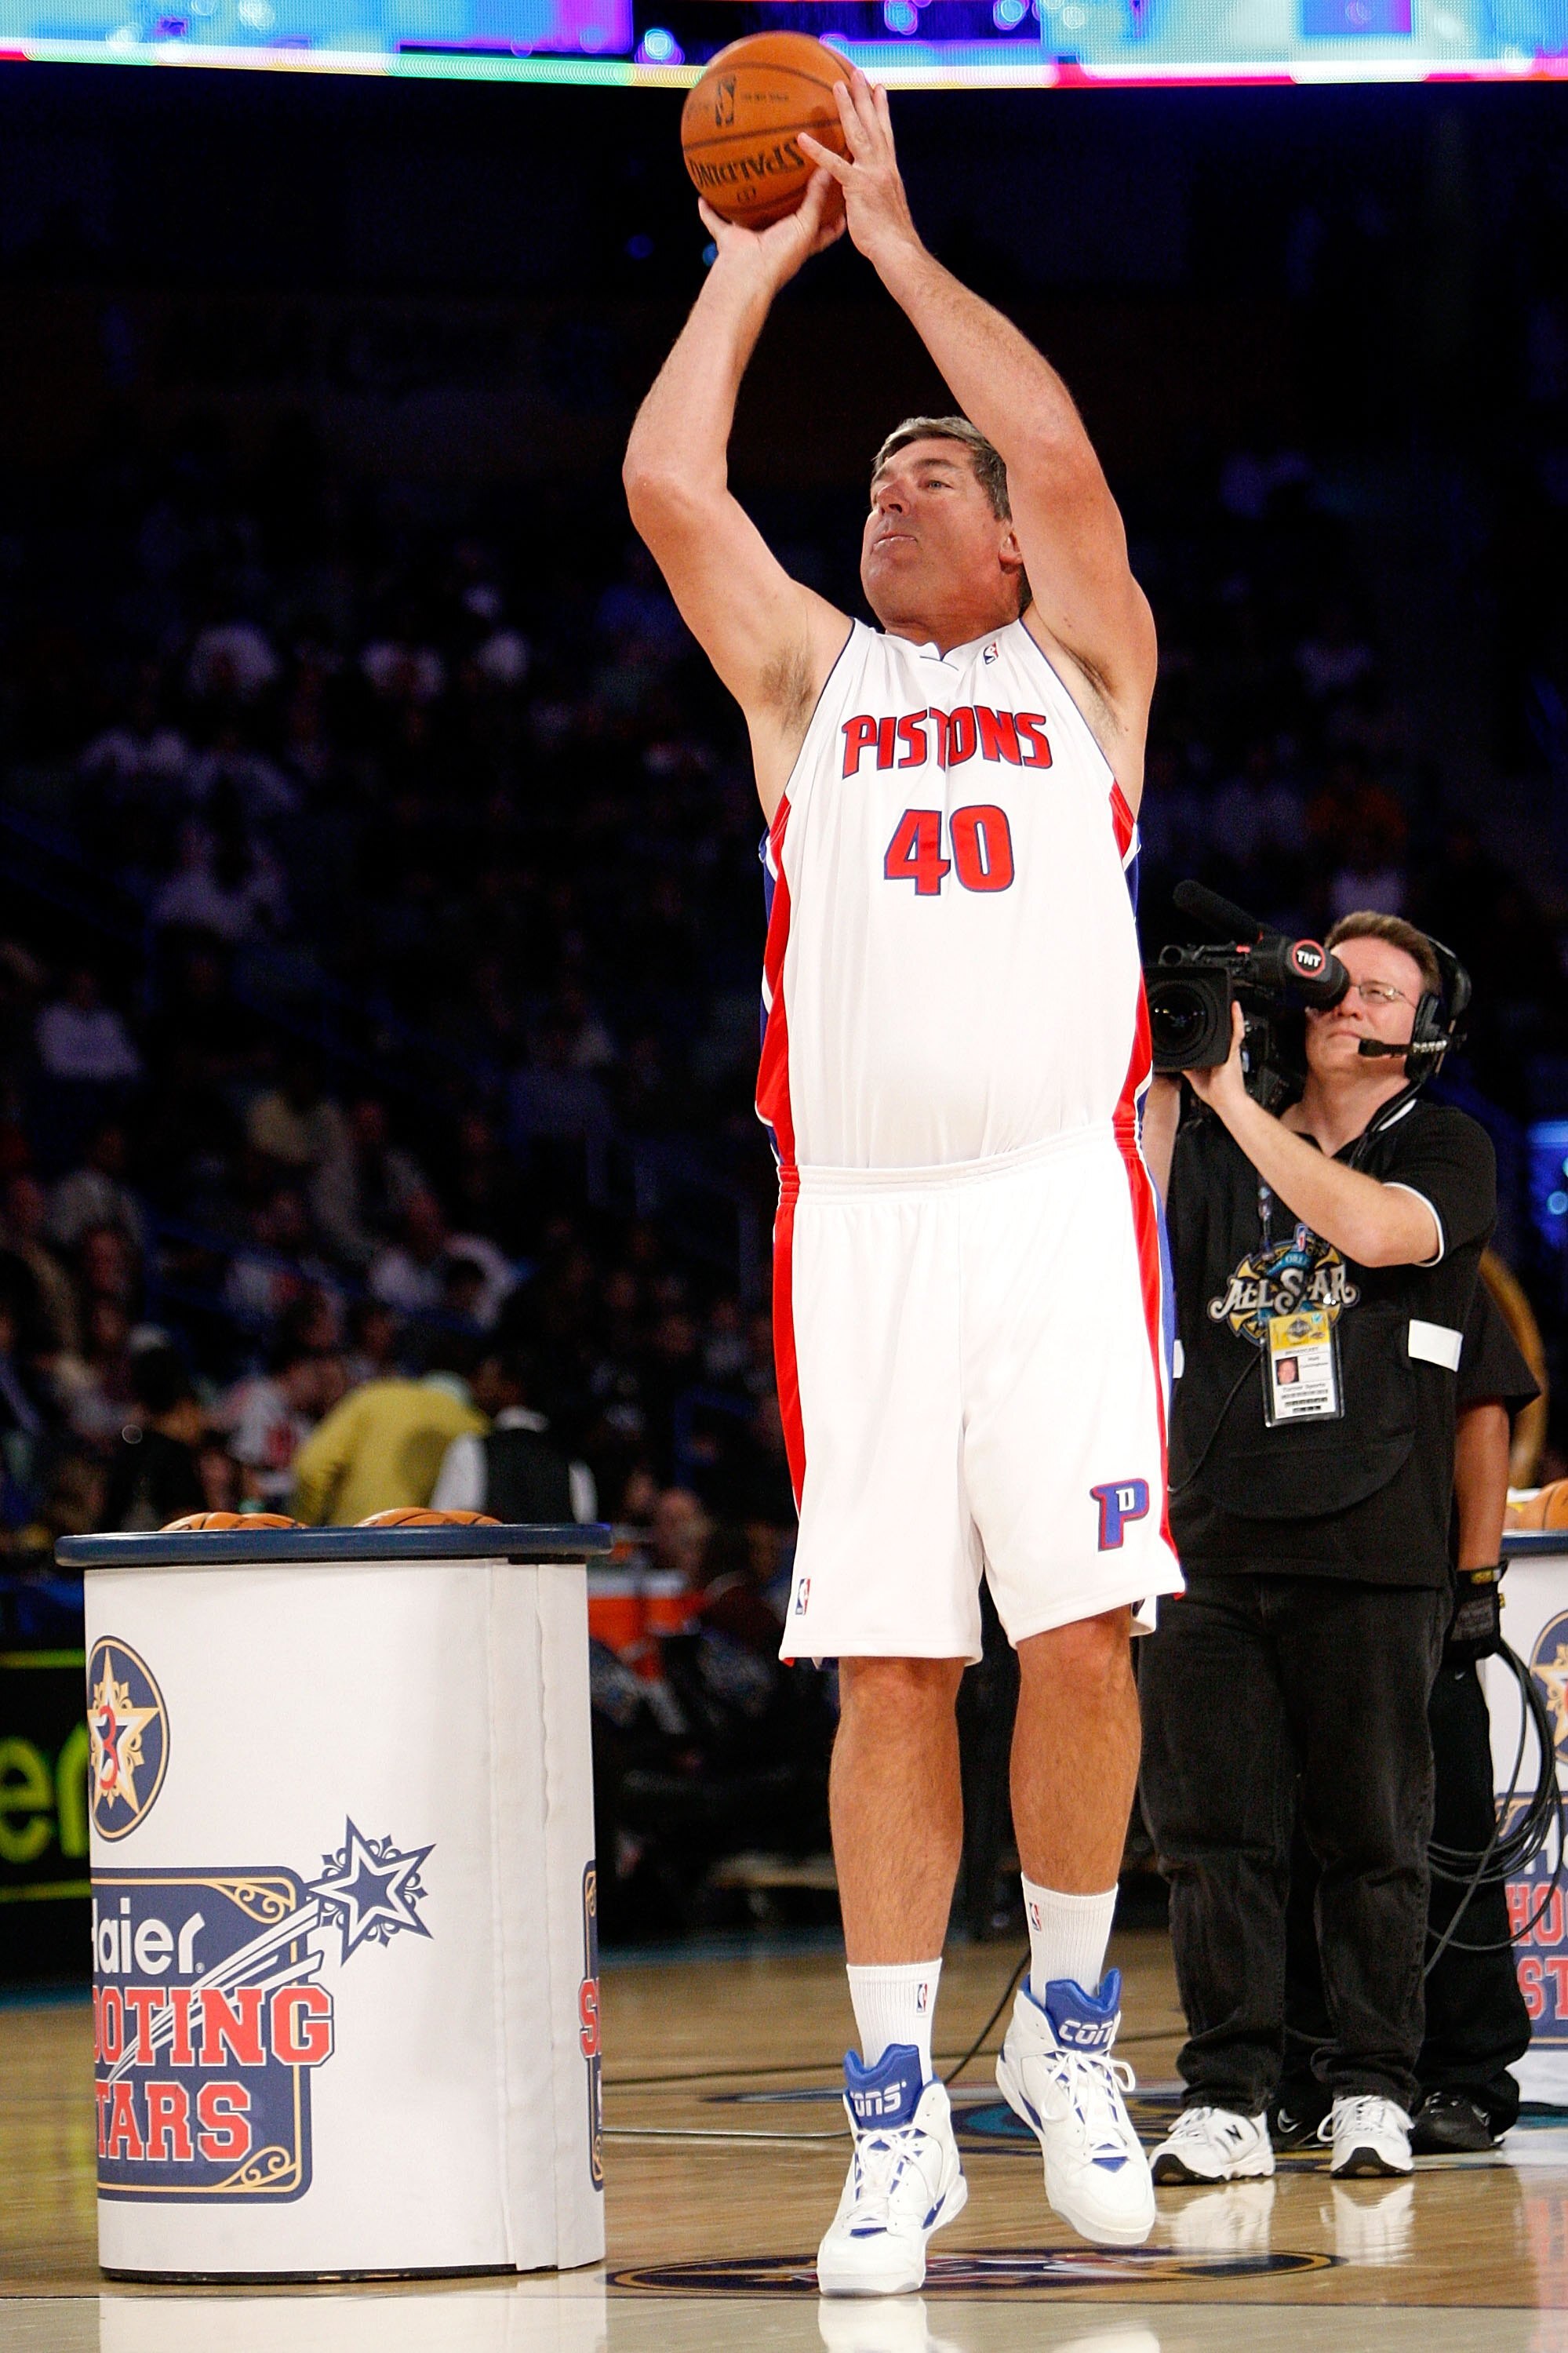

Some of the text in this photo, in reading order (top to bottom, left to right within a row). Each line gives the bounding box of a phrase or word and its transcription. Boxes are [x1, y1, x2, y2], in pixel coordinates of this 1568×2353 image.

[842, 704, 1053, 780] PISTONS
[884, 804, 1015, 896] 40
[1297, 945, 1322, 967] TNT
[91, 1897, 206, 1975] aier
[1505, 1882, 1568, 1946] HO
